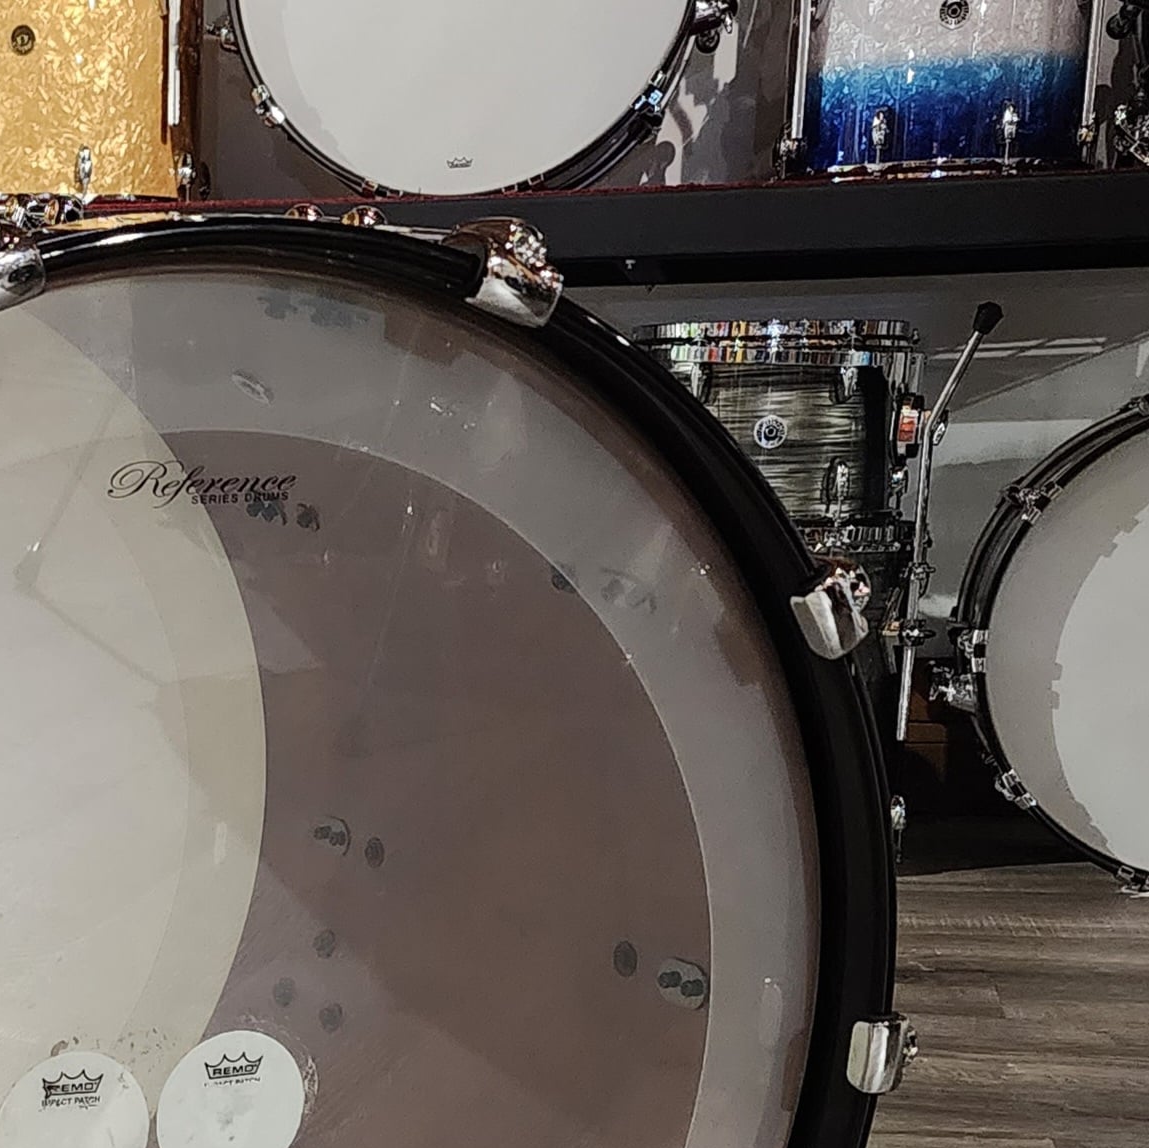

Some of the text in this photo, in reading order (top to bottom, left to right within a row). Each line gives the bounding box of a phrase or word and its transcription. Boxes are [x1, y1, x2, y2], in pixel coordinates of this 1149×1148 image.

[107, 460, 297, 509] Reference
[191, 491, 289, 505] SERIES DRUMS
[213, 1064, 254, 1076] REMO
